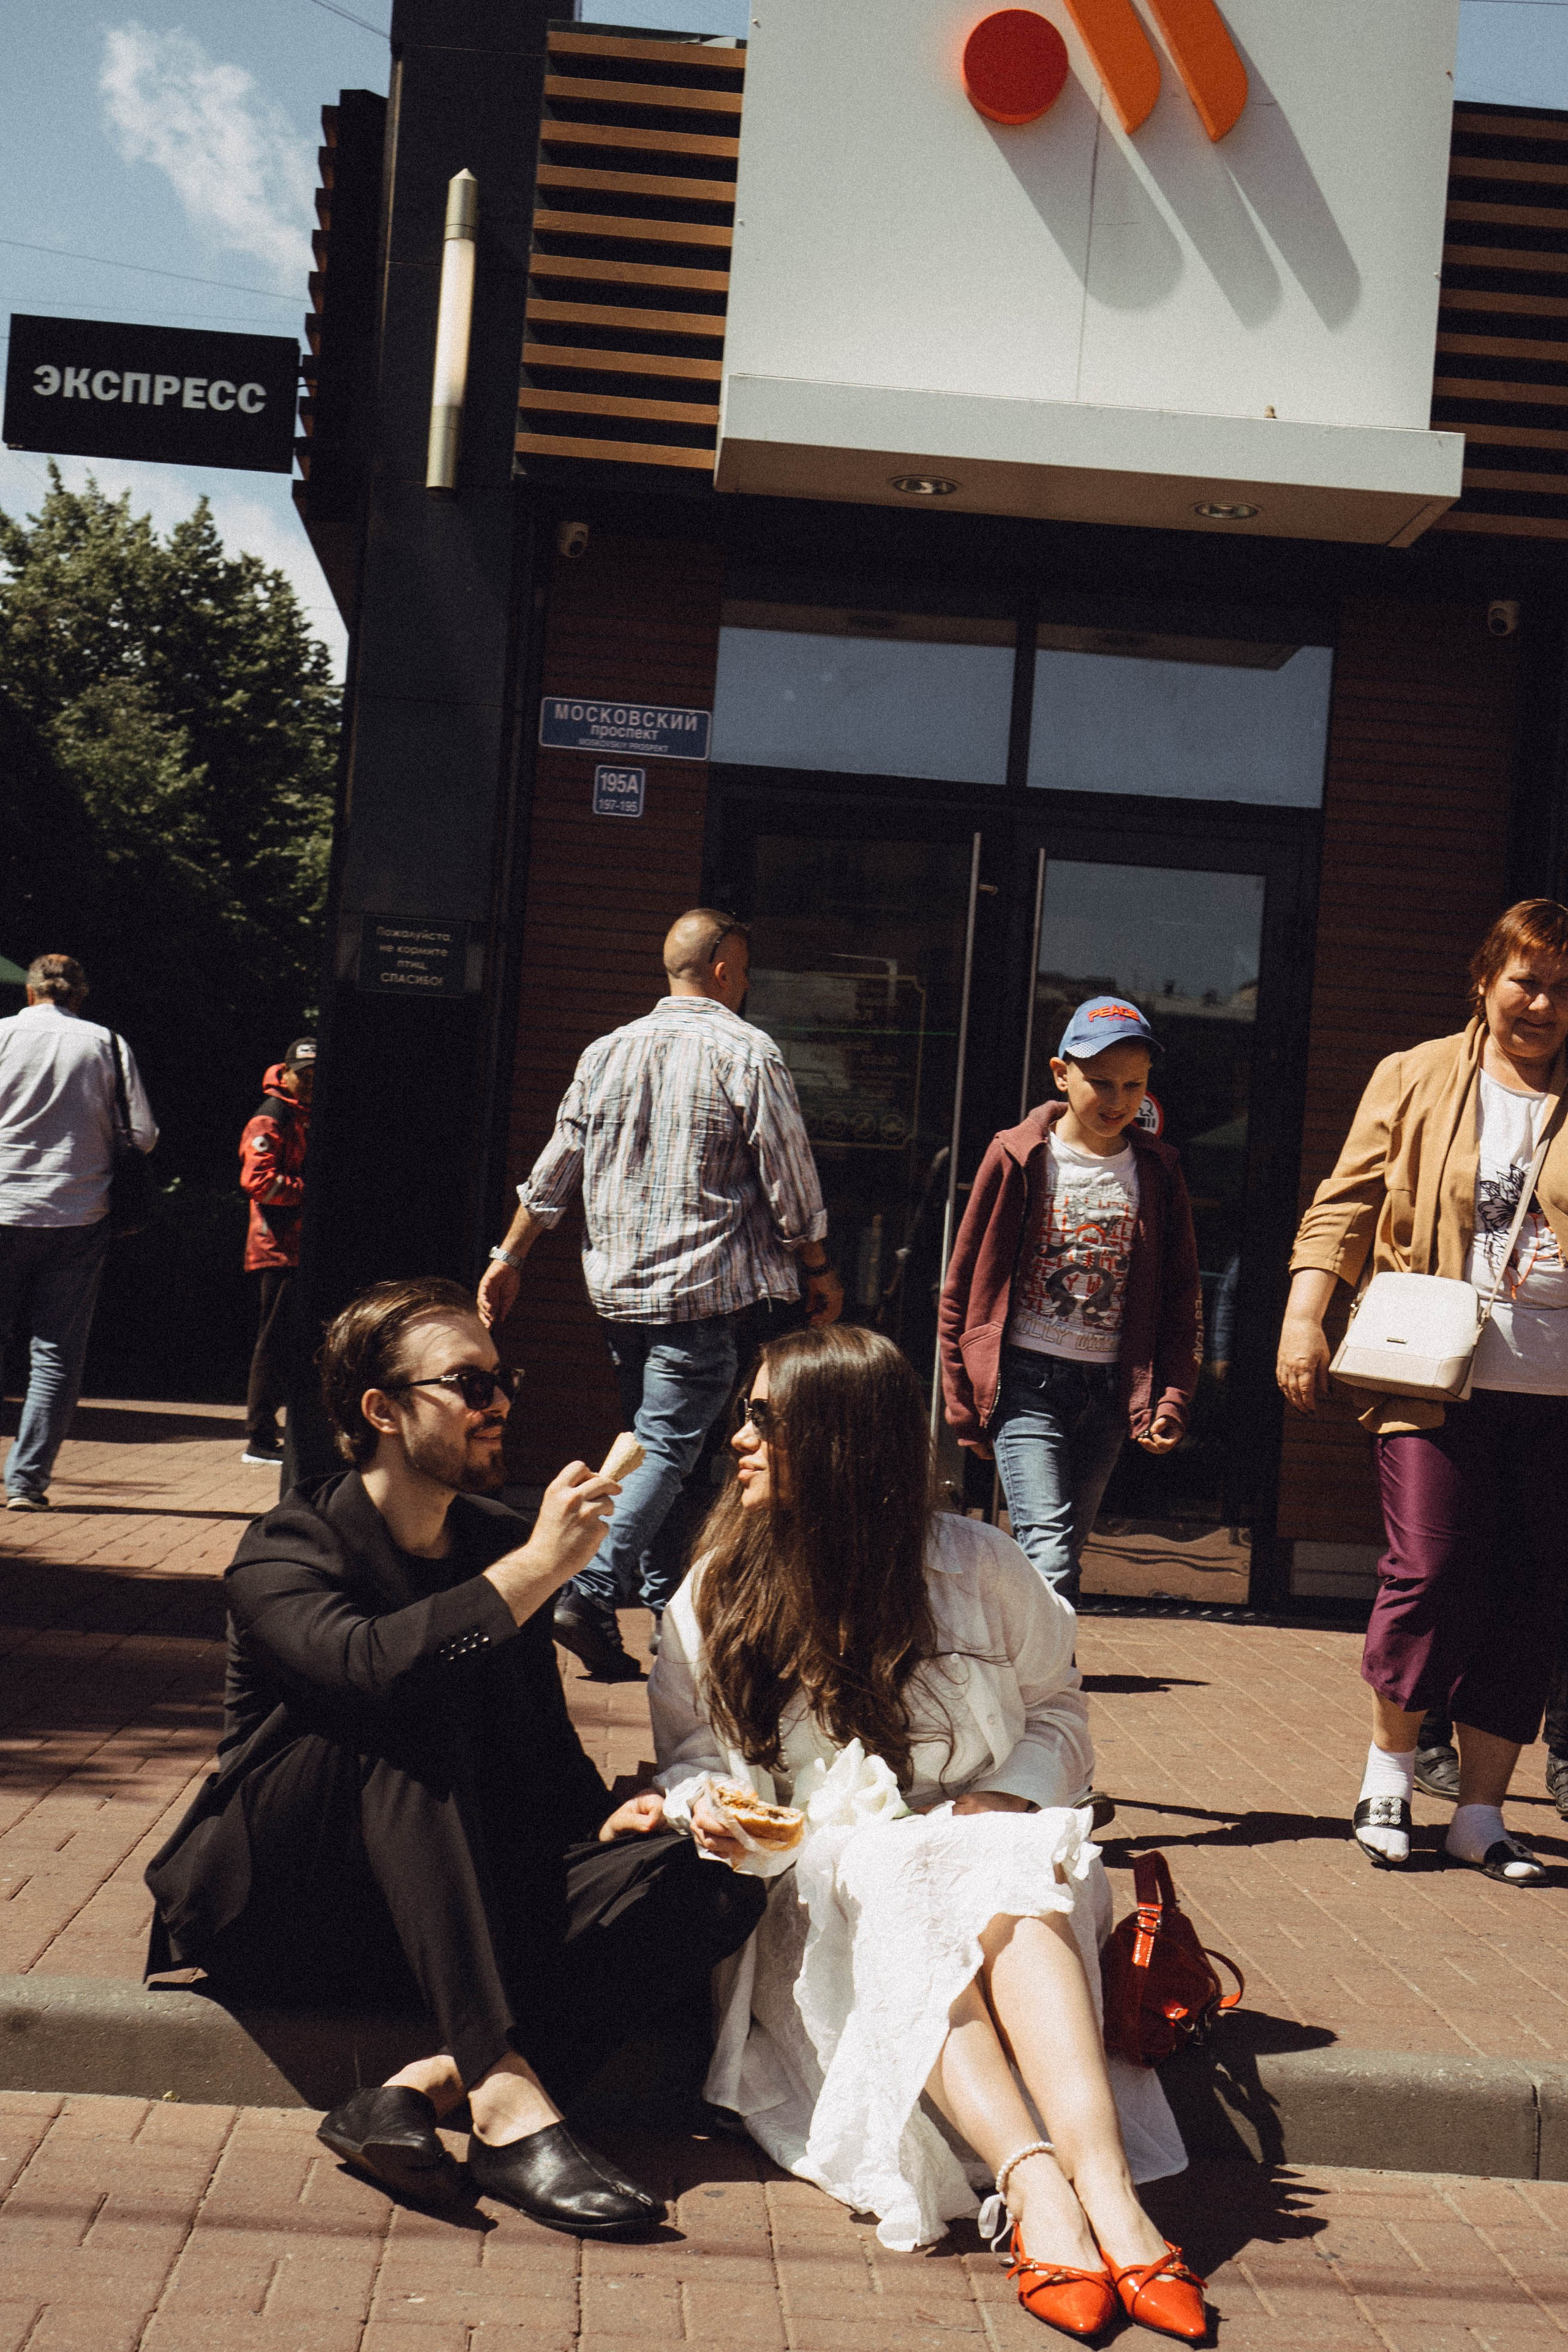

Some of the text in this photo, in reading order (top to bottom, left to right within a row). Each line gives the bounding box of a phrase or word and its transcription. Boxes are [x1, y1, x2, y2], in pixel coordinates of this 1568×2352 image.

[32, 364, 267, 413] ЭКСПРЕСС
[555, 704, 698, 731] МОСКОВСКИЙ
[590, 725, 659, 740] проспект
[396, 946, 449, 957] кормите
[1087, 1005, 1140, 1022] PEACE
